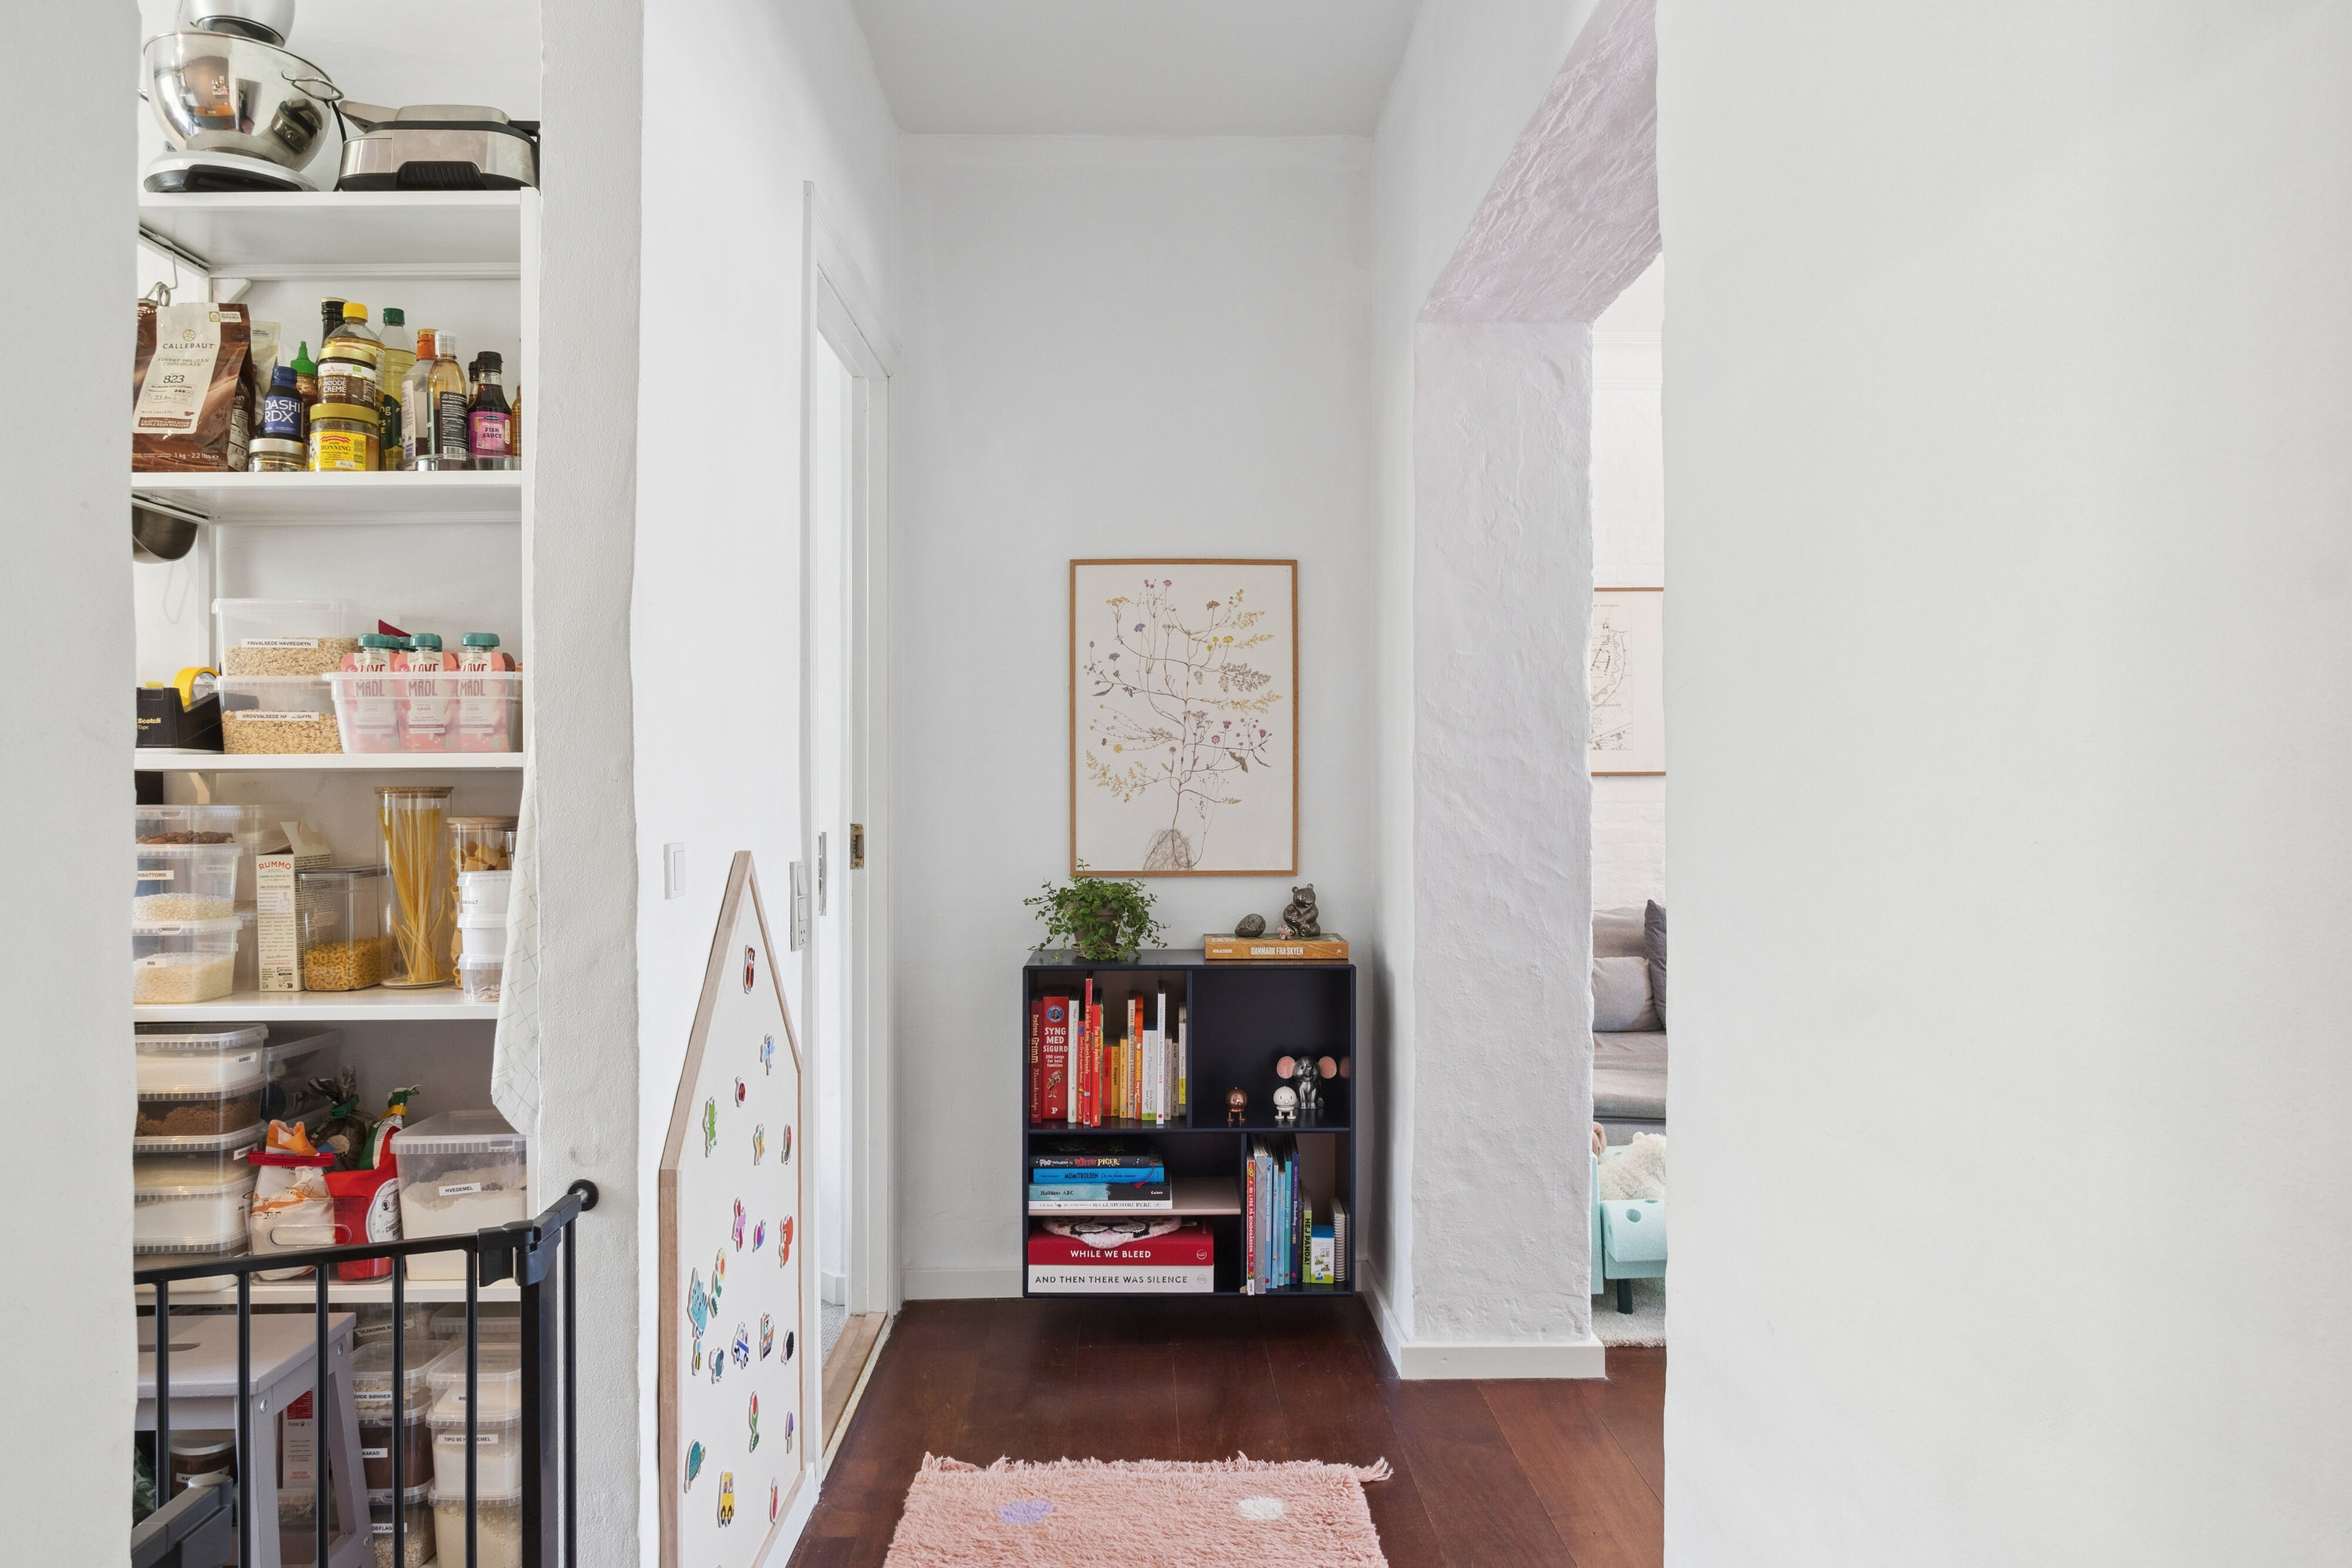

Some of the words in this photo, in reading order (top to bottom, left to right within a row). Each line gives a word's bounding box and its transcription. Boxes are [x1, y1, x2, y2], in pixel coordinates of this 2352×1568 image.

[163, 375, 185, 383] 823
[265, 400, 300, 413] DASHI
[264, 410, 294, 423] RDX
[258, 861, 292, 870] RUMMO
[1047, 1036, 1064, 1044] MED
[1031, 1037, 1040, 1063] Grimm
[1098, 1157, 1120, 1166] PIGER
